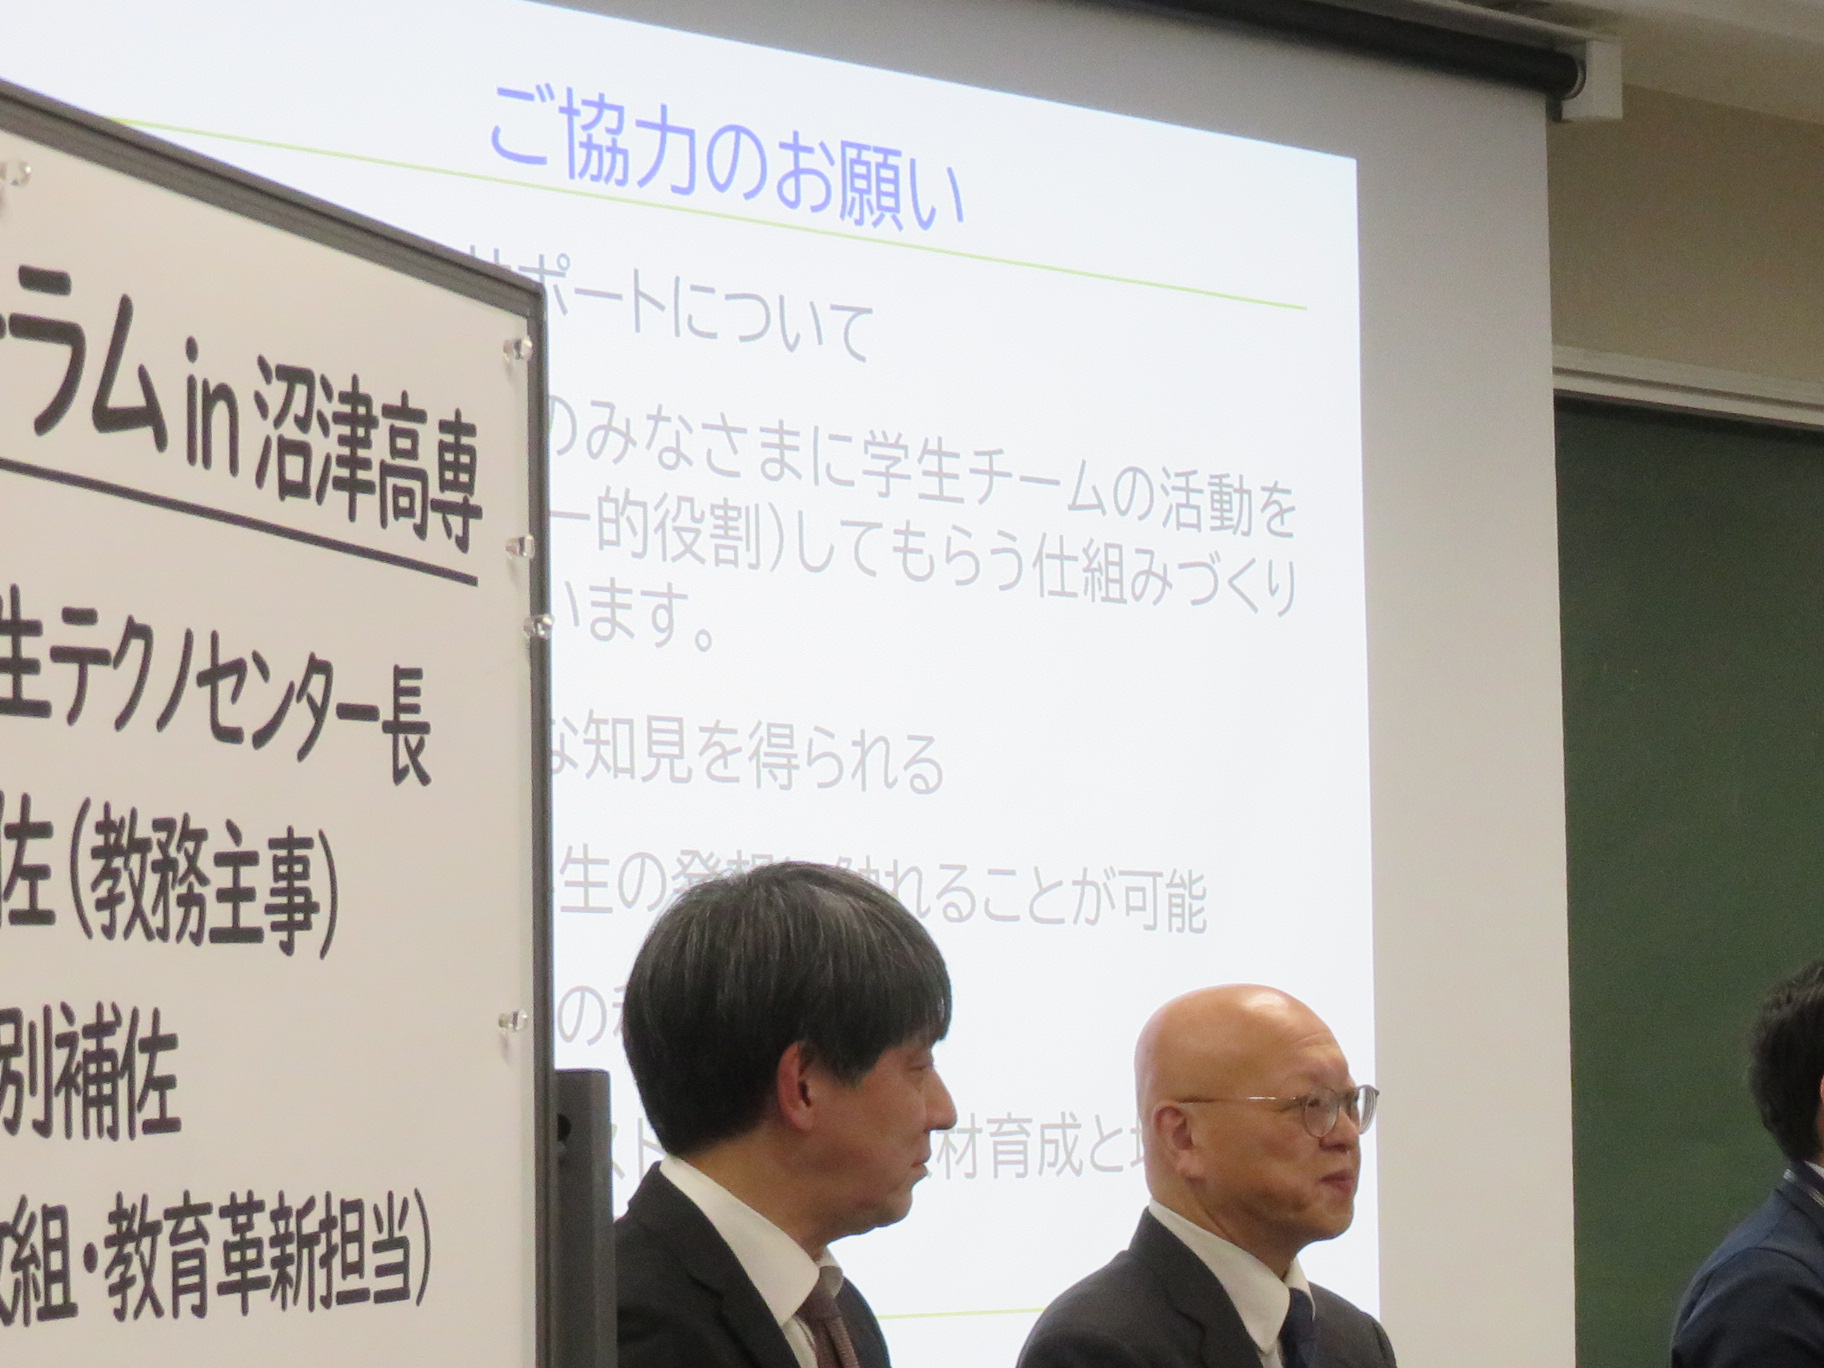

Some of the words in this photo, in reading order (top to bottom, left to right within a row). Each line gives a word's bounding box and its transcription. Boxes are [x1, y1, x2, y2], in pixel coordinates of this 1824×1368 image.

[491, 82, 965, 232] ご協力のお願い
[0, 264, 483, 554] ラムin沼津高専
[0, 583, 431, 787] 生テクノセンター長
[551, 708, 945, 796] な知見を得られる
[0, 790, 339, 959] 佐(教務主事)
[0, 1000, 182, 1142] 別補佐
[557, 983, 626, 1047] の
[927, 1110, 1145, 1181] 材育成と
